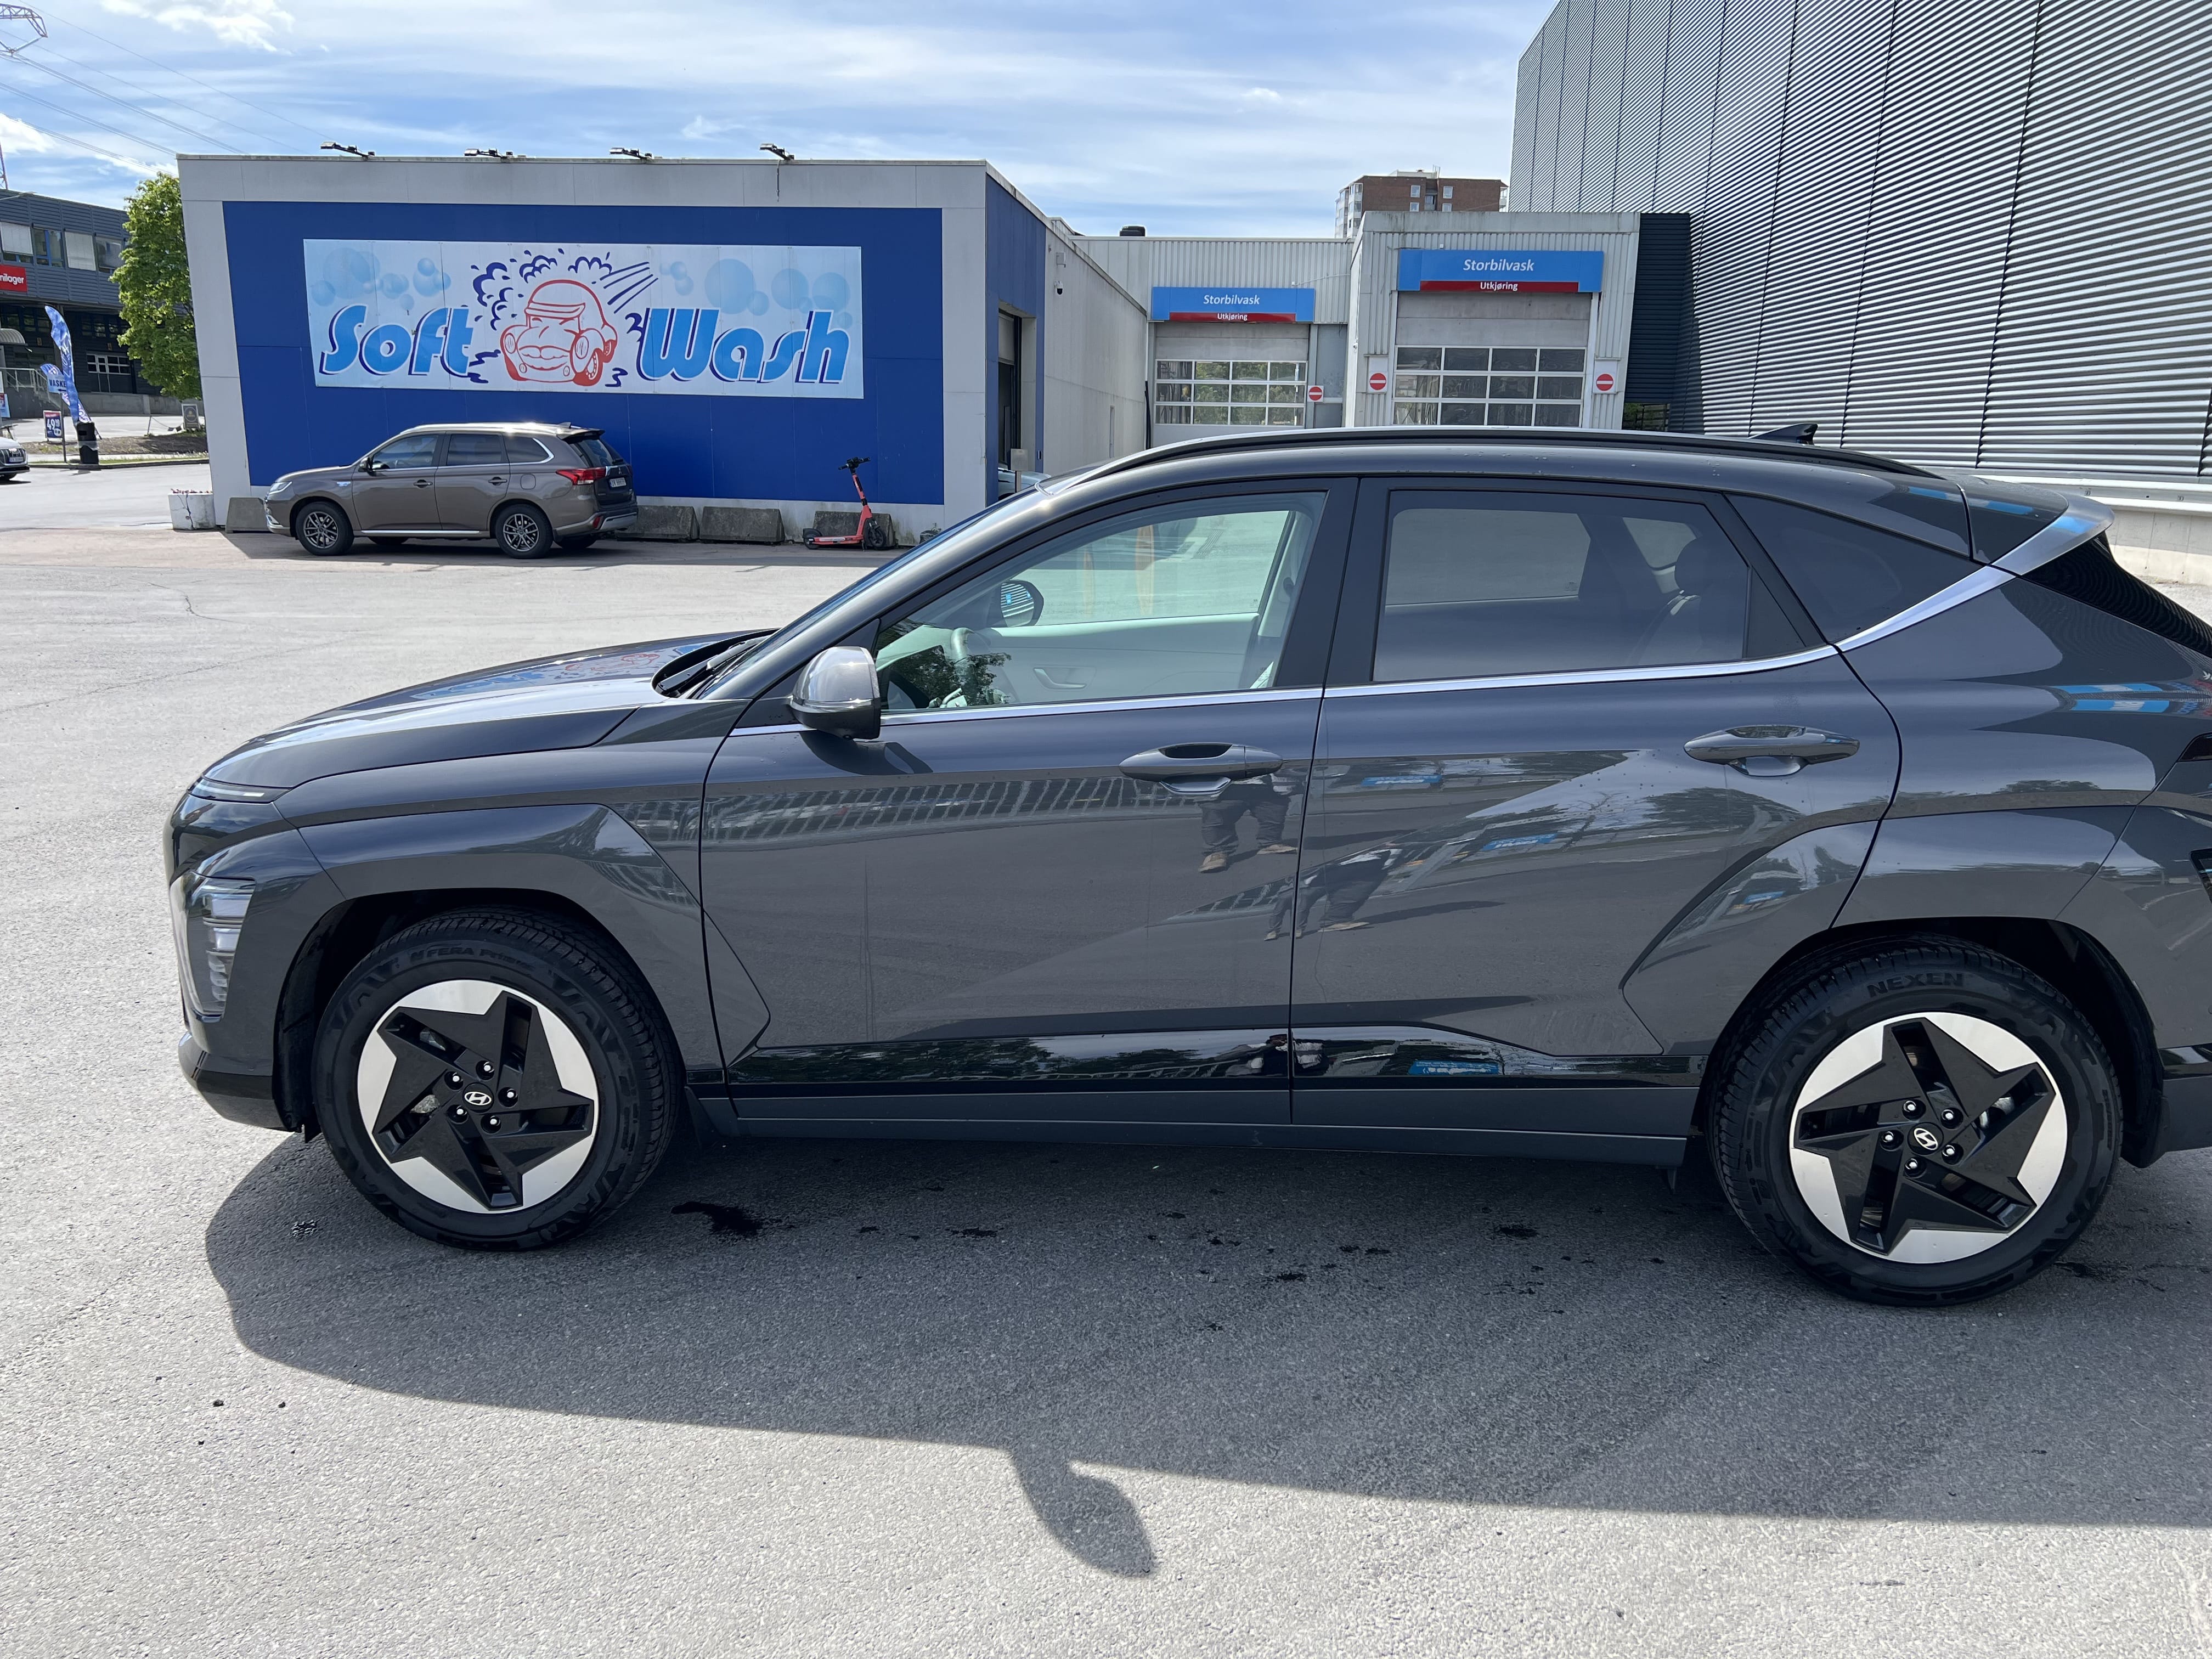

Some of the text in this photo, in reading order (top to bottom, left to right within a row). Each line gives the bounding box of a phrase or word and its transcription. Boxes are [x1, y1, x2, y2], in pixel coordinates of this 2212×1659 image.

[1463, 258, 1535, 272] Storbilvask
[1480, 281, 1519, 291] Utkjøring
[1203, 294, 1260, 305] Storbilvask
[1217, 313, 1248, 321] Utkjøring
[319, 303, 850, 383] Soft Wash
[1866, 973, 1963, 998] NEXEN
